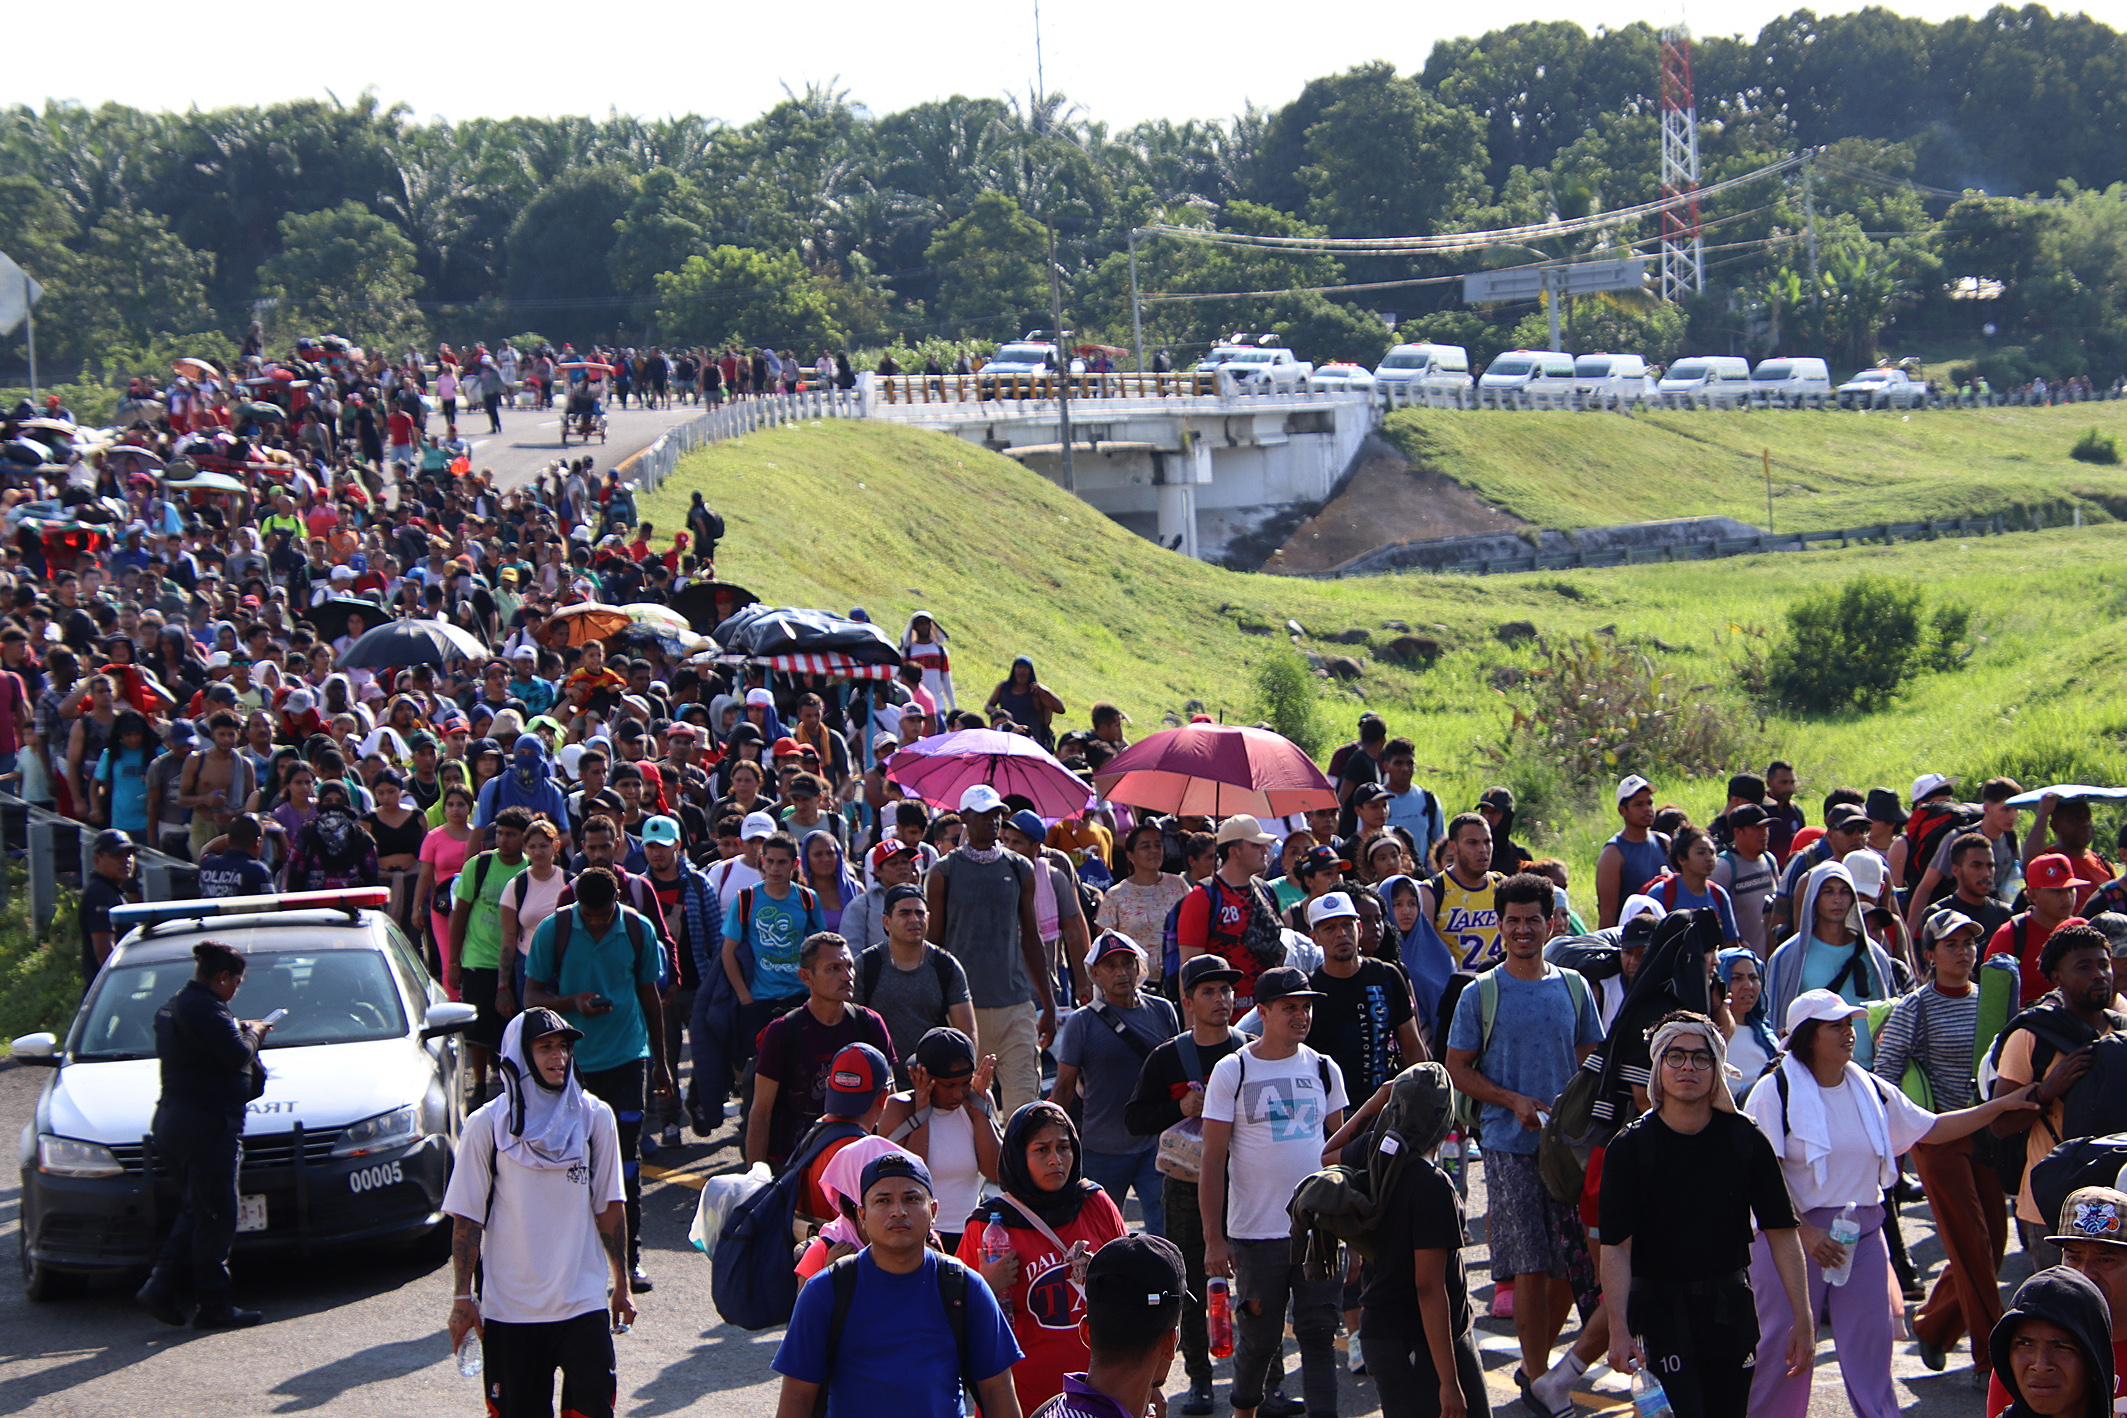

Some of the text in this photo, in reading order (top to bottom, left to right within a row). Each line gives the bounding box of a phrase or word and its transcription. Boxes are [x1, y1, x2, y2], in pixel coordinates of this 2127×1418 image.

[1221, 905, 1240, 923] 28
[1458, 930, 1503, 970] 24
[1357, 1003, 1370, 1083] CALIFORNIA
[1365, 986, 1389, 1086] HOLLISTE
[350, 1160, 403, 1193] 00005
[1025, 1252, 1063, 1282] DAL
[1660, 1354, 1681, 1373] 10
